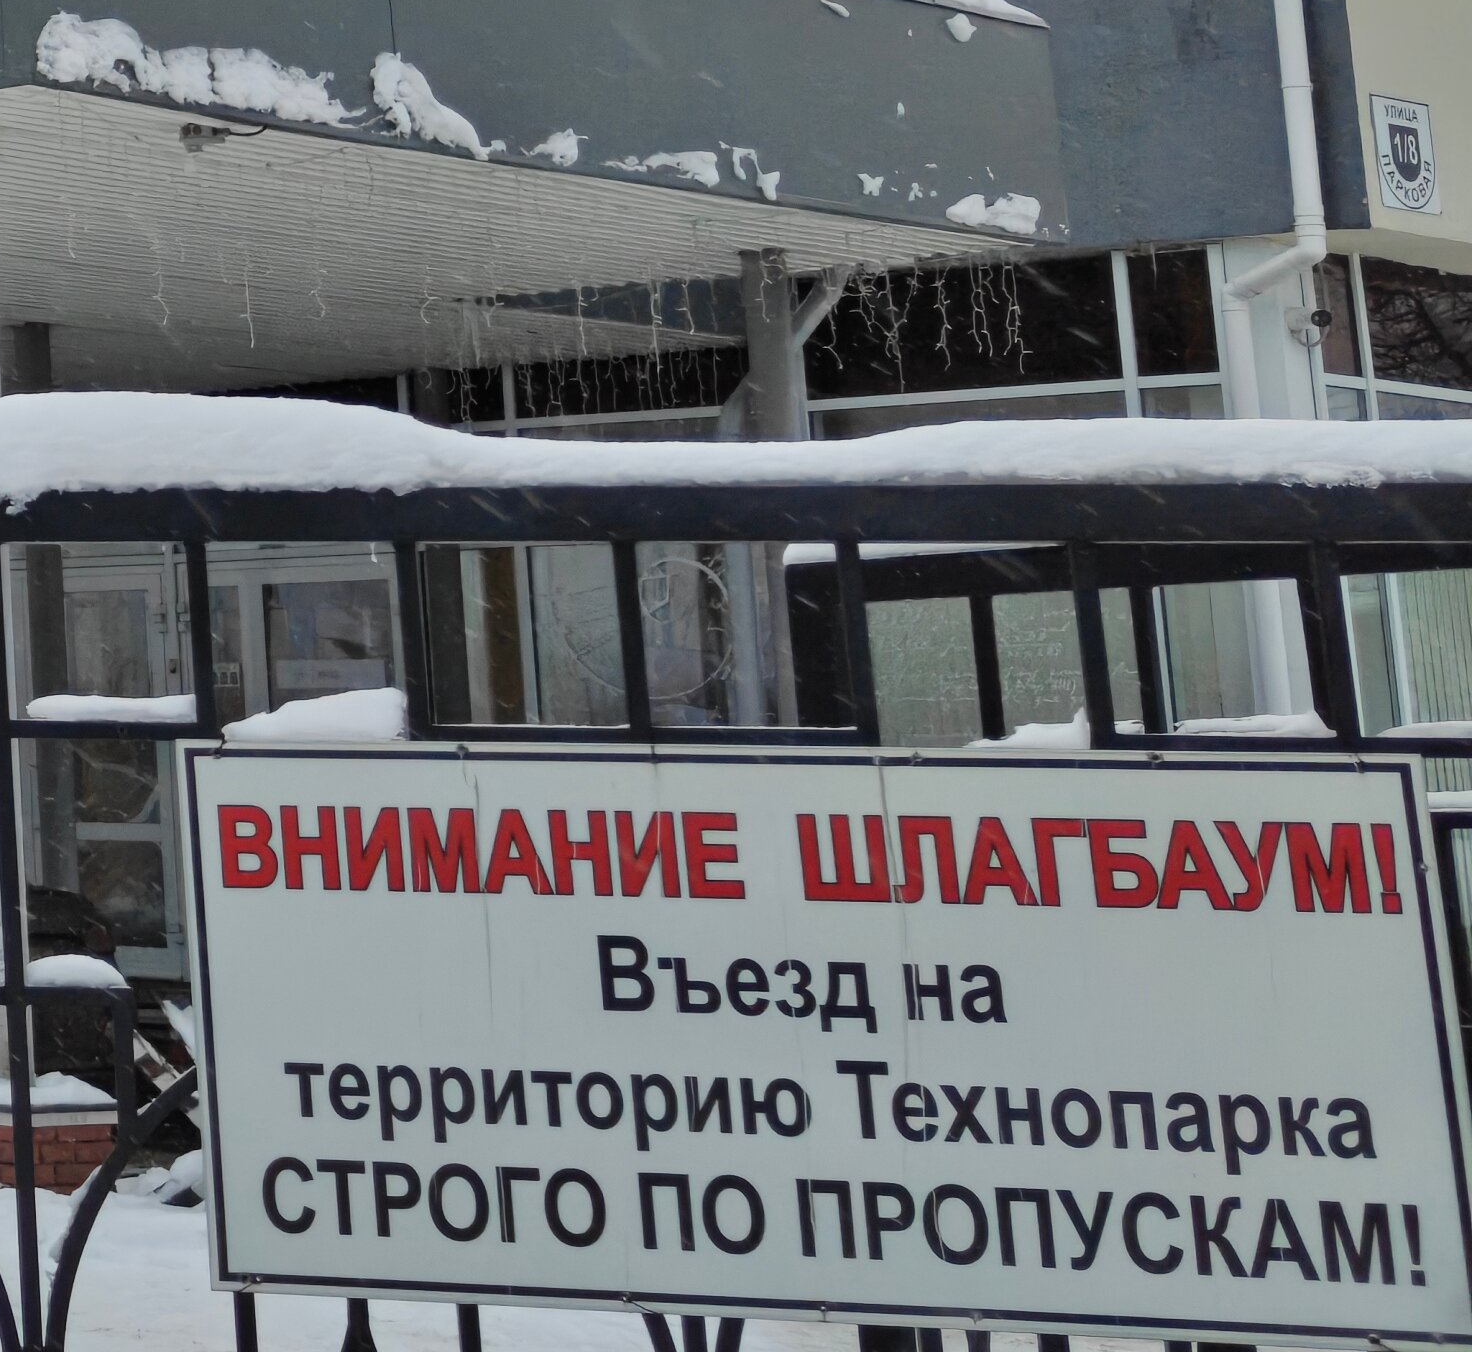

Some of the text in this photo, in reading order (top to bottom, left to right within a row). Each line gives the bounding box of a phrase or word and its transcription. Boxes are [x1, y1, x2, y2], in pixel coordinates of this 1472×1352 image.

[1384, 104, 1418, 123] УЛИЦА
[1394, 132, 1419, 165] 1/8
[1381, 154, 1432, 202] ПАРКОВАЯ
[217, 803, 1404, 915] ВНИМАНИЕ ШЛАГБАУМ!
[597, 933, 1008, 1035] Въезд на
[284, 1059, 1377, 1175] территорию Технопарка
[262, 1156, 1428, 1289] СТРОГО ПО ПРОПУСКАМ!
